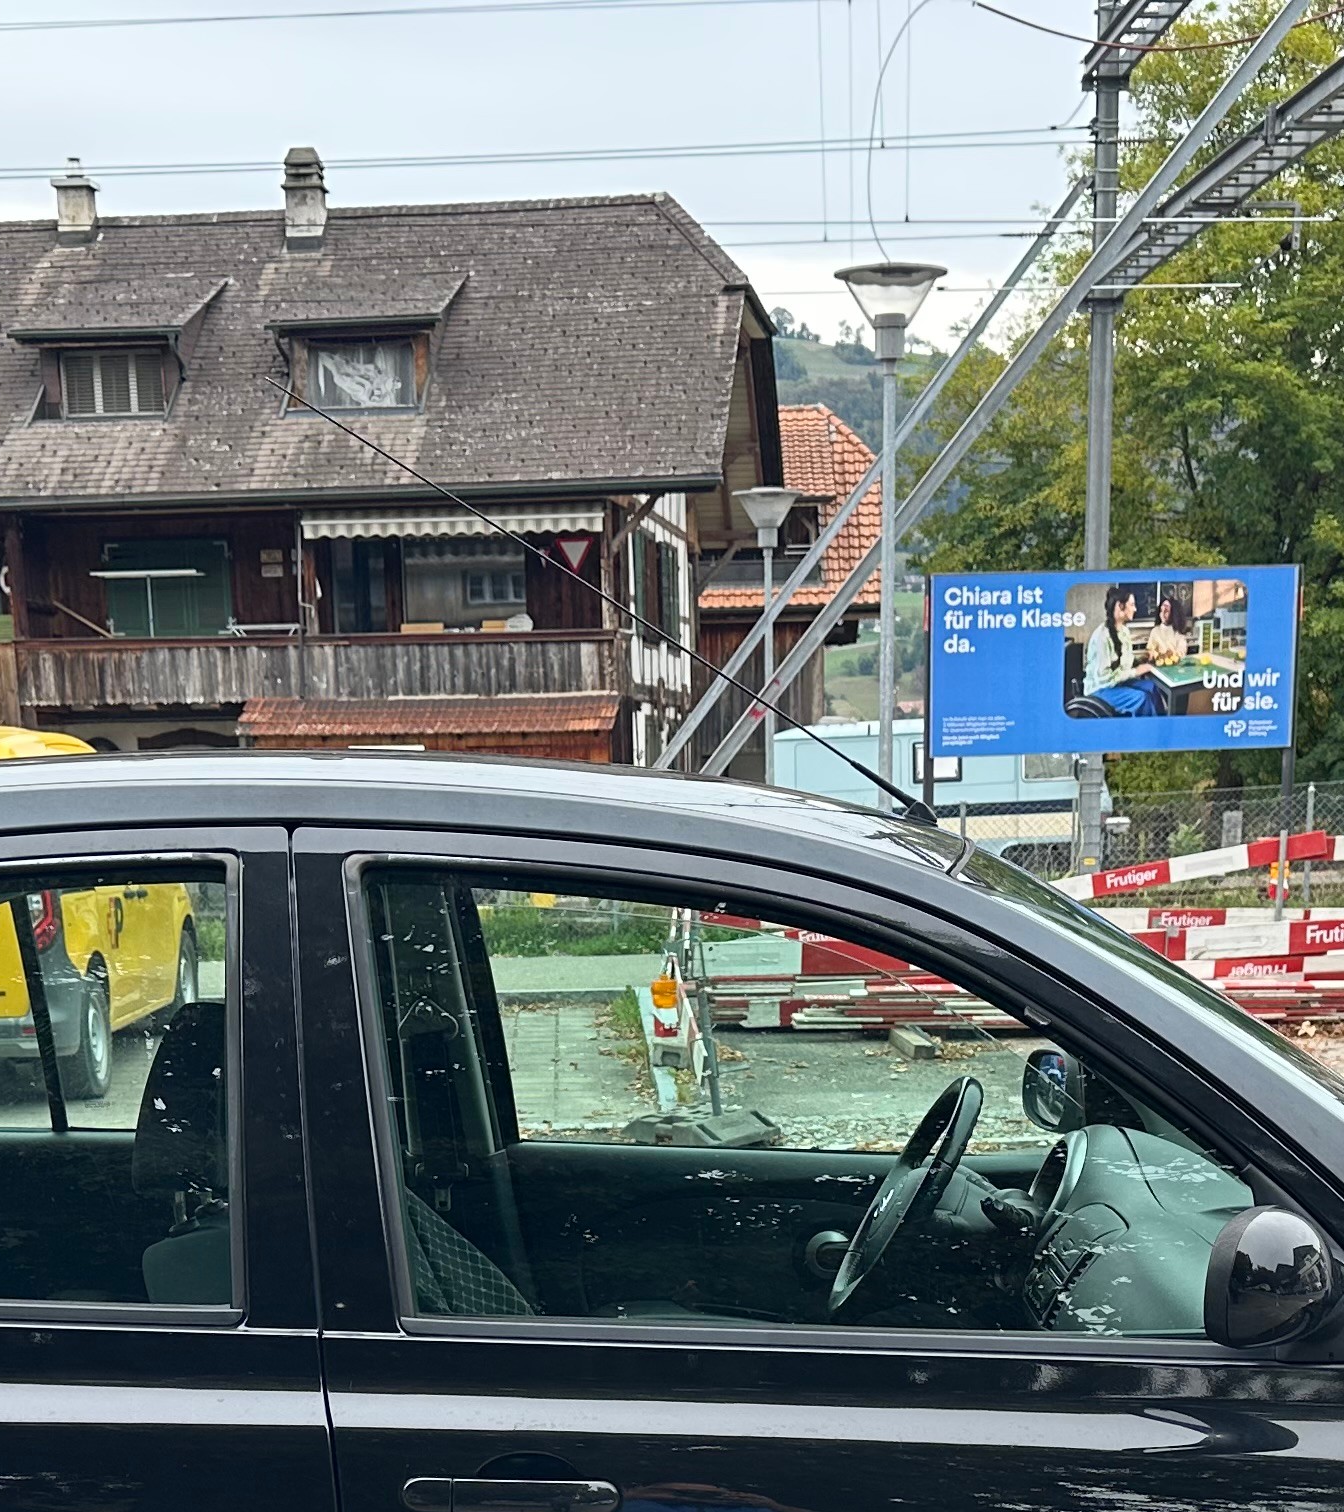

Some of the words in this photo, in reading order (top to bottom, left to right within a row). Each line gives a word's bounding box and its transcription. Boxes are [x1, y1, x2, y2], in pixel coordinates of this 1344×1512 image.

[944, 586, 1012, 606] Chiara
[1017, 585, 1043, 604] ist
[943, 610, 973, 630] für
[977, 609, 1017, 629] ihre
[1021, 608, 1086, 628] Klasse
[943, 634, 976, 653] da.
[1203, 669, 1243, 689] Und
[1248, 667, 1280, 687] wir
[1212, 691, 1241, 711] für
[1243, 691, 1278, 710] sie.
[1105, 868, 1158, 889] Frutiger
[1161, 911, 1213, 927] Frutiger
